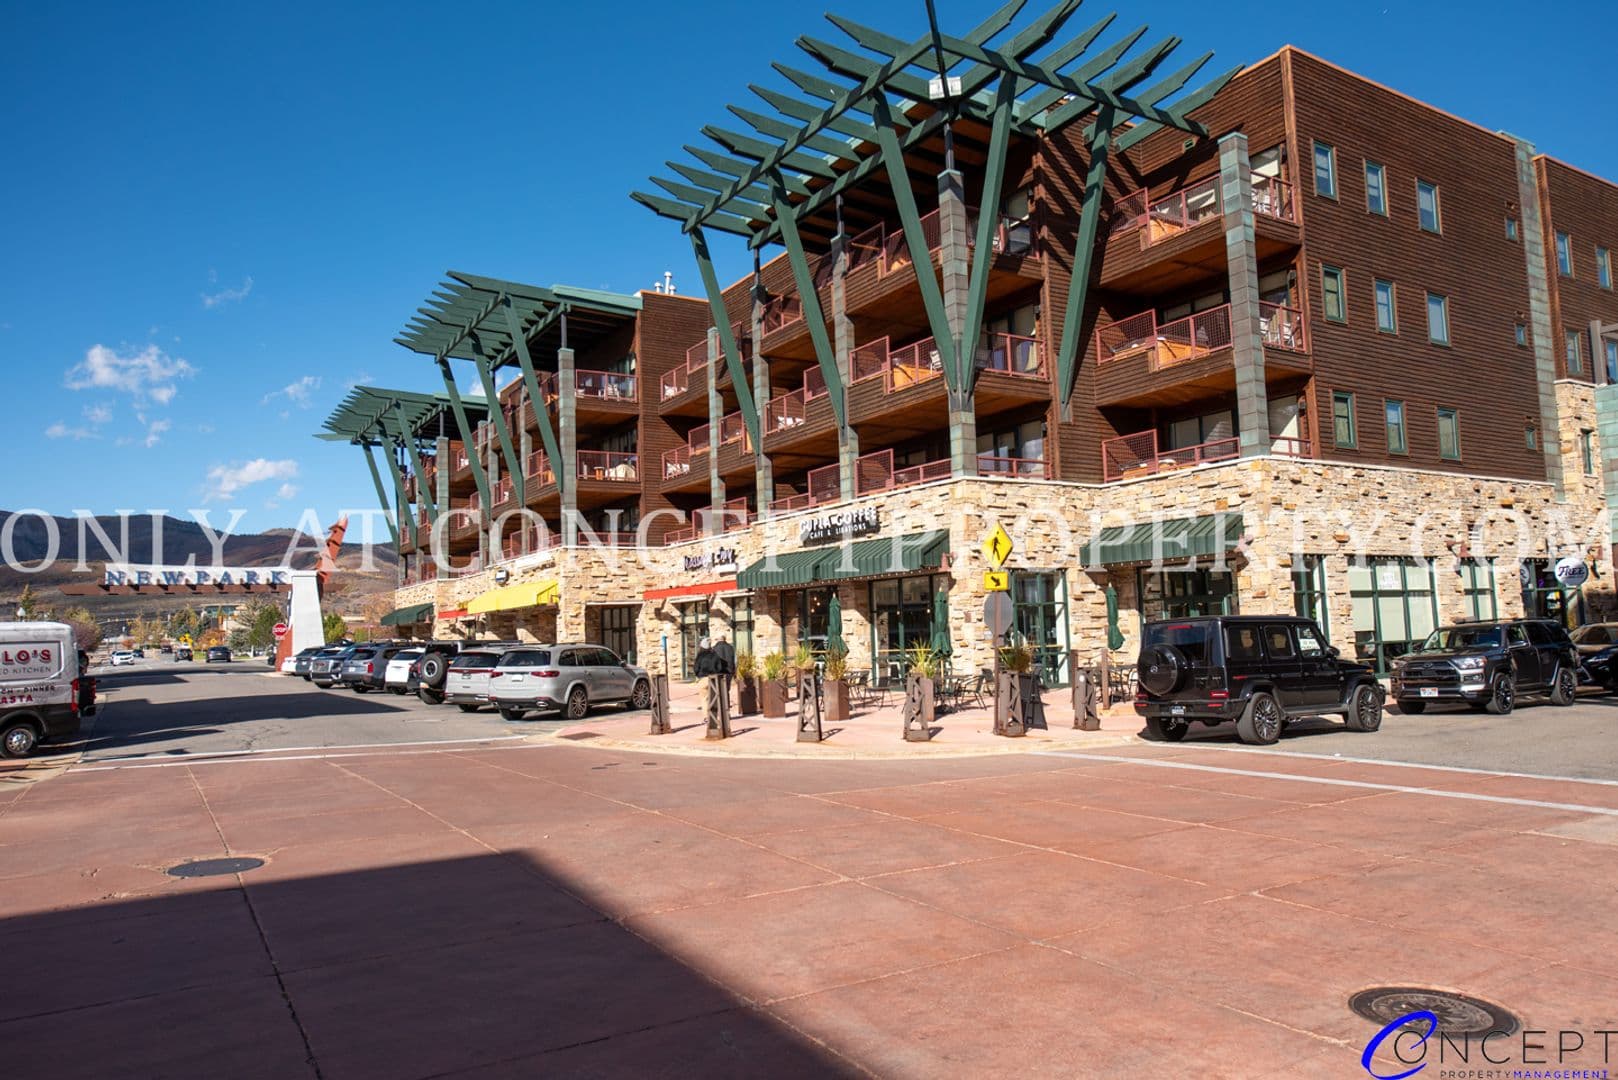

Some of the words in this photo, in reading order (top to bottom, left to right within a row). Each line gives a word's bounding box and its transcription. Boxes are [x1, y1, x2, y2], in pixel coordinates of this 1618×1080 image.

[836, 506, 878, 526] COFFEE
[106, 570, 289, 586] NEWPARK
[24, 685, 55, 693] DINNER
